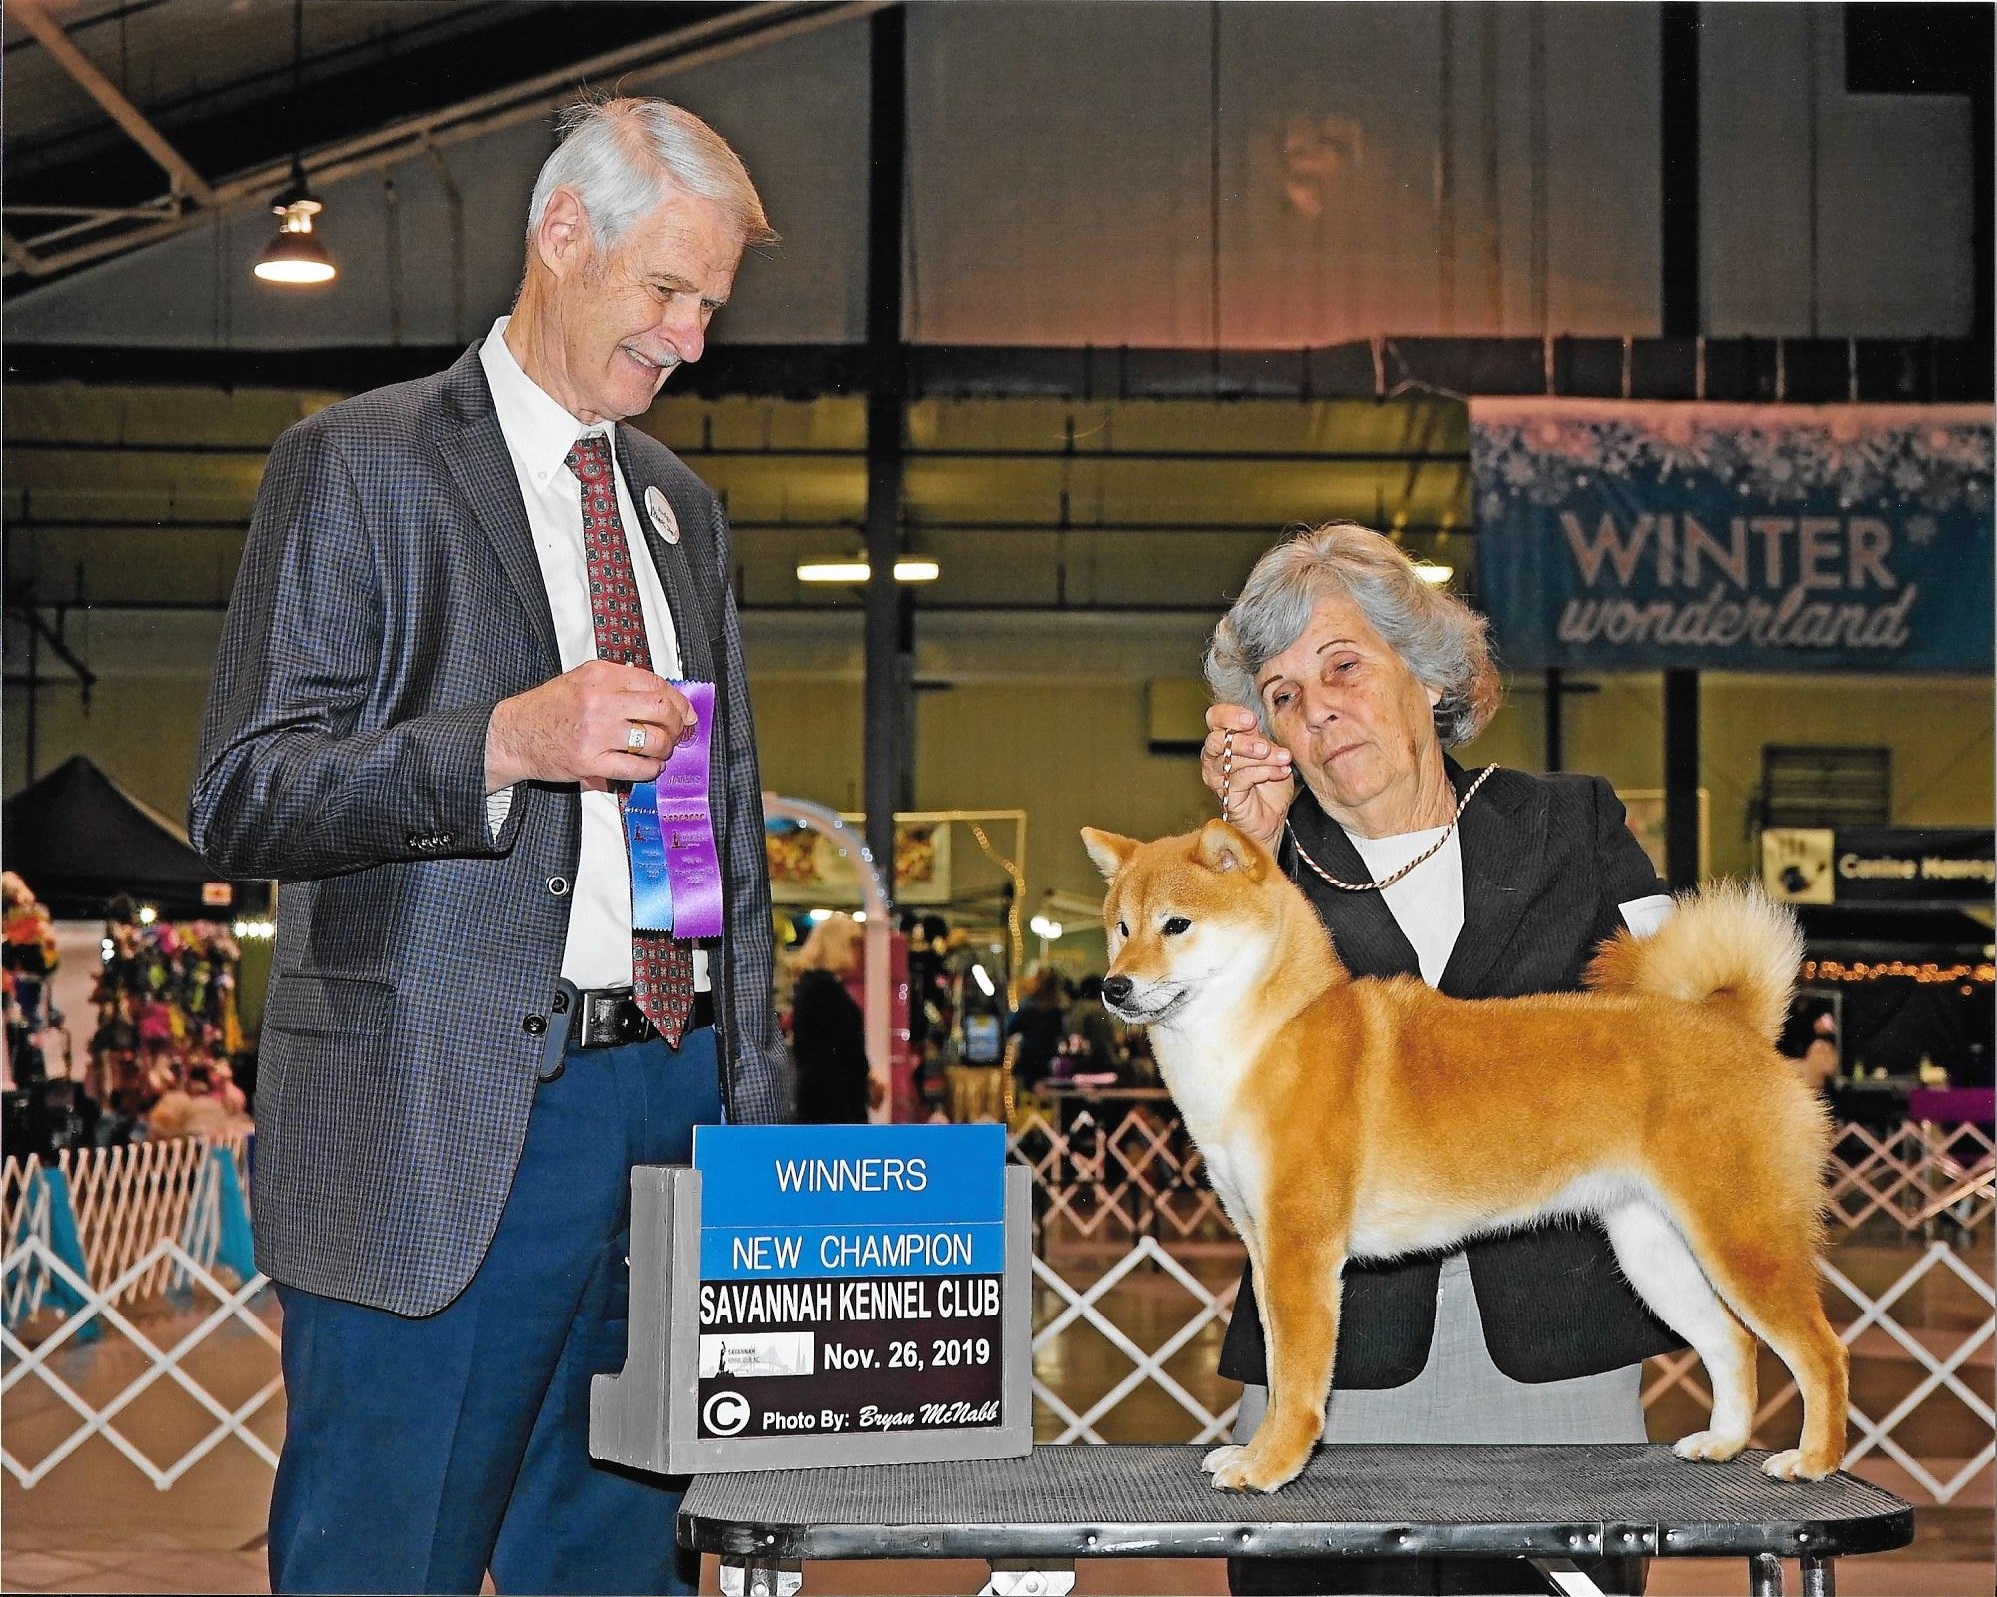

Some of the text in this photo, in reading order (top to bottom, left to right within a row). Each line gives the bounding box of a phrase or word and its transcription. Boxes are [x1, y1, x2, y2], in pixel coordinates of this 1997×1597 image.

[1560, 512, 1898, 589] WINTER
[1556, 583, 1917, 648] wonderland
[775, 1158, 927, 1193] WINNERS
[733, 1233, 972, 1270] NEW CHAMPION
[700, 1279, 1000, 1325] SAVANNAH KENNEL CLUB
[824, 1338, 990, 1371] Nov. 26, 2019
[762, 1400, 998, 1432] Photo By: Bryan McNabb
